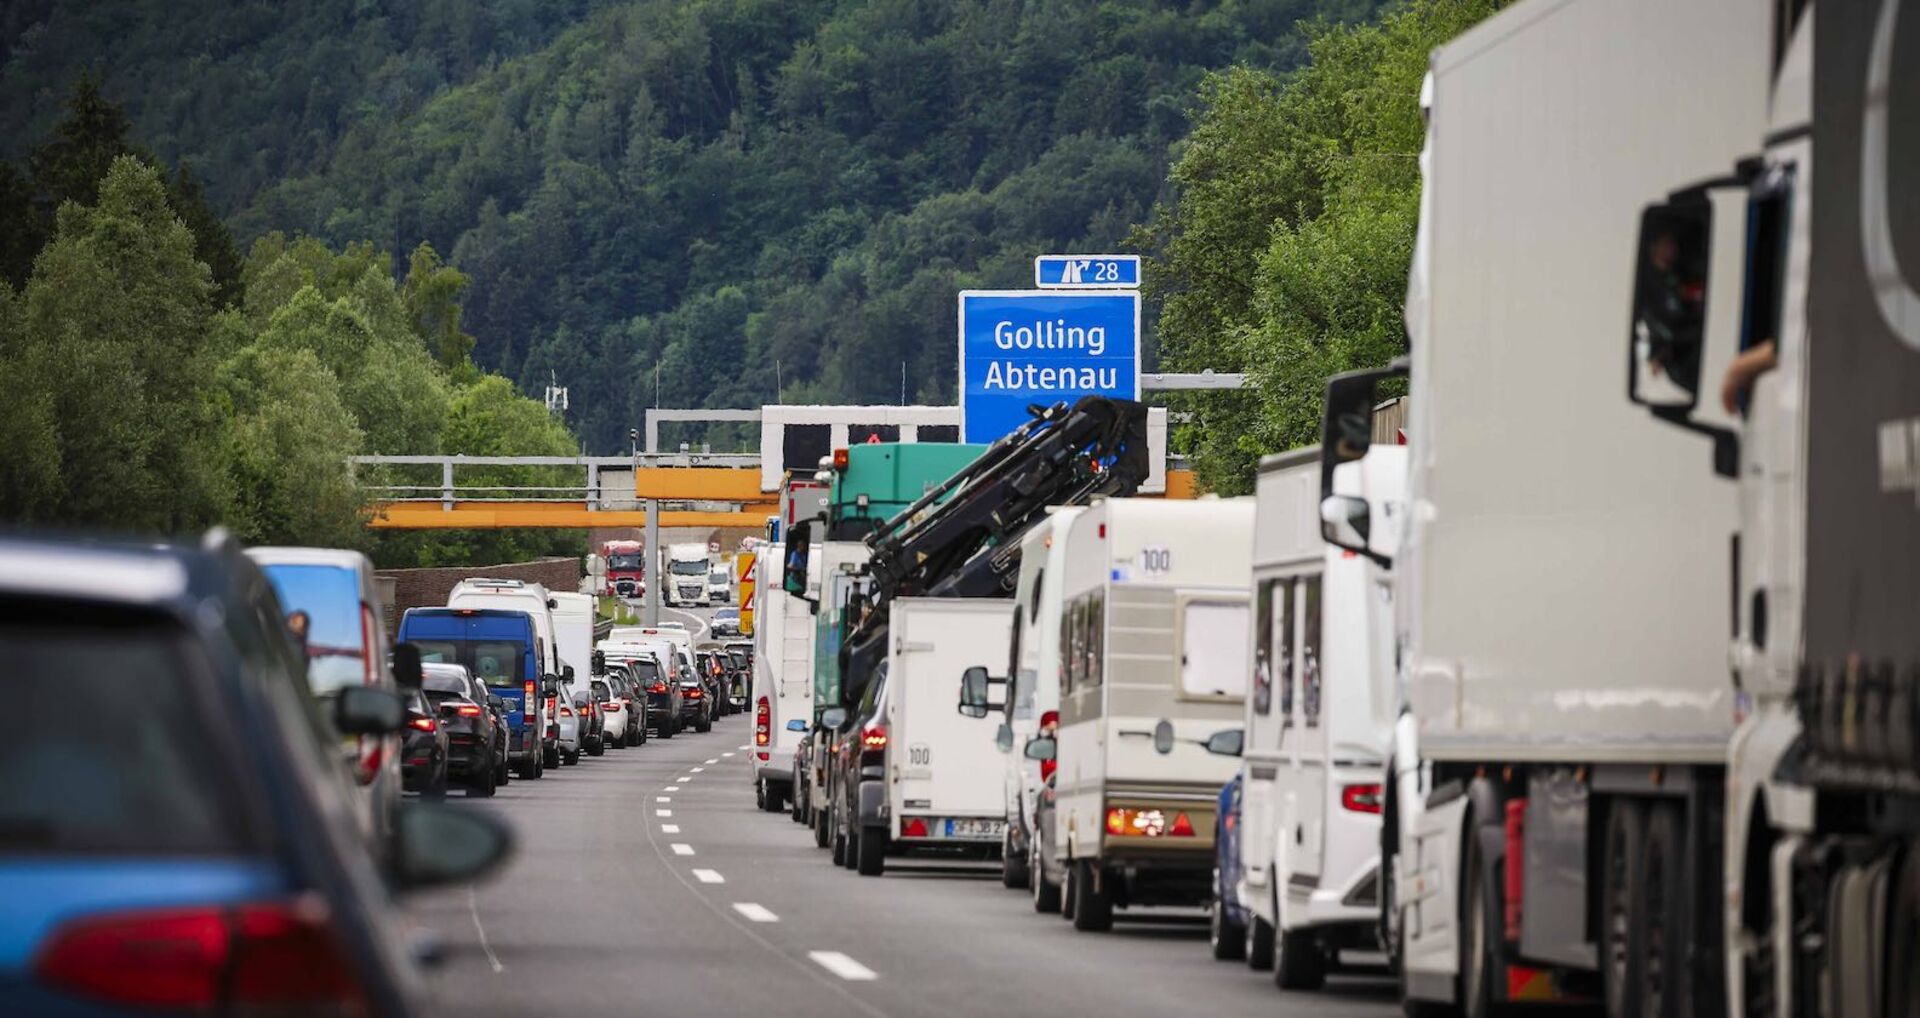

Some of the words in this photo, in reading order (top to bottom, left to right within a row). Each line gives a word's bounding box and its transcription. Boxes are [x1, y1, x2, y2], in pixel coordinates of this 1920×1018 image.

[1095, 262, 1119, 281] 28
[994, 319, 1105, 356] Golling
[983, 361, 1117, 390] Abtenau
[1143, 549, 1170, 571] 100
[909, 748, 930, 765] 100
